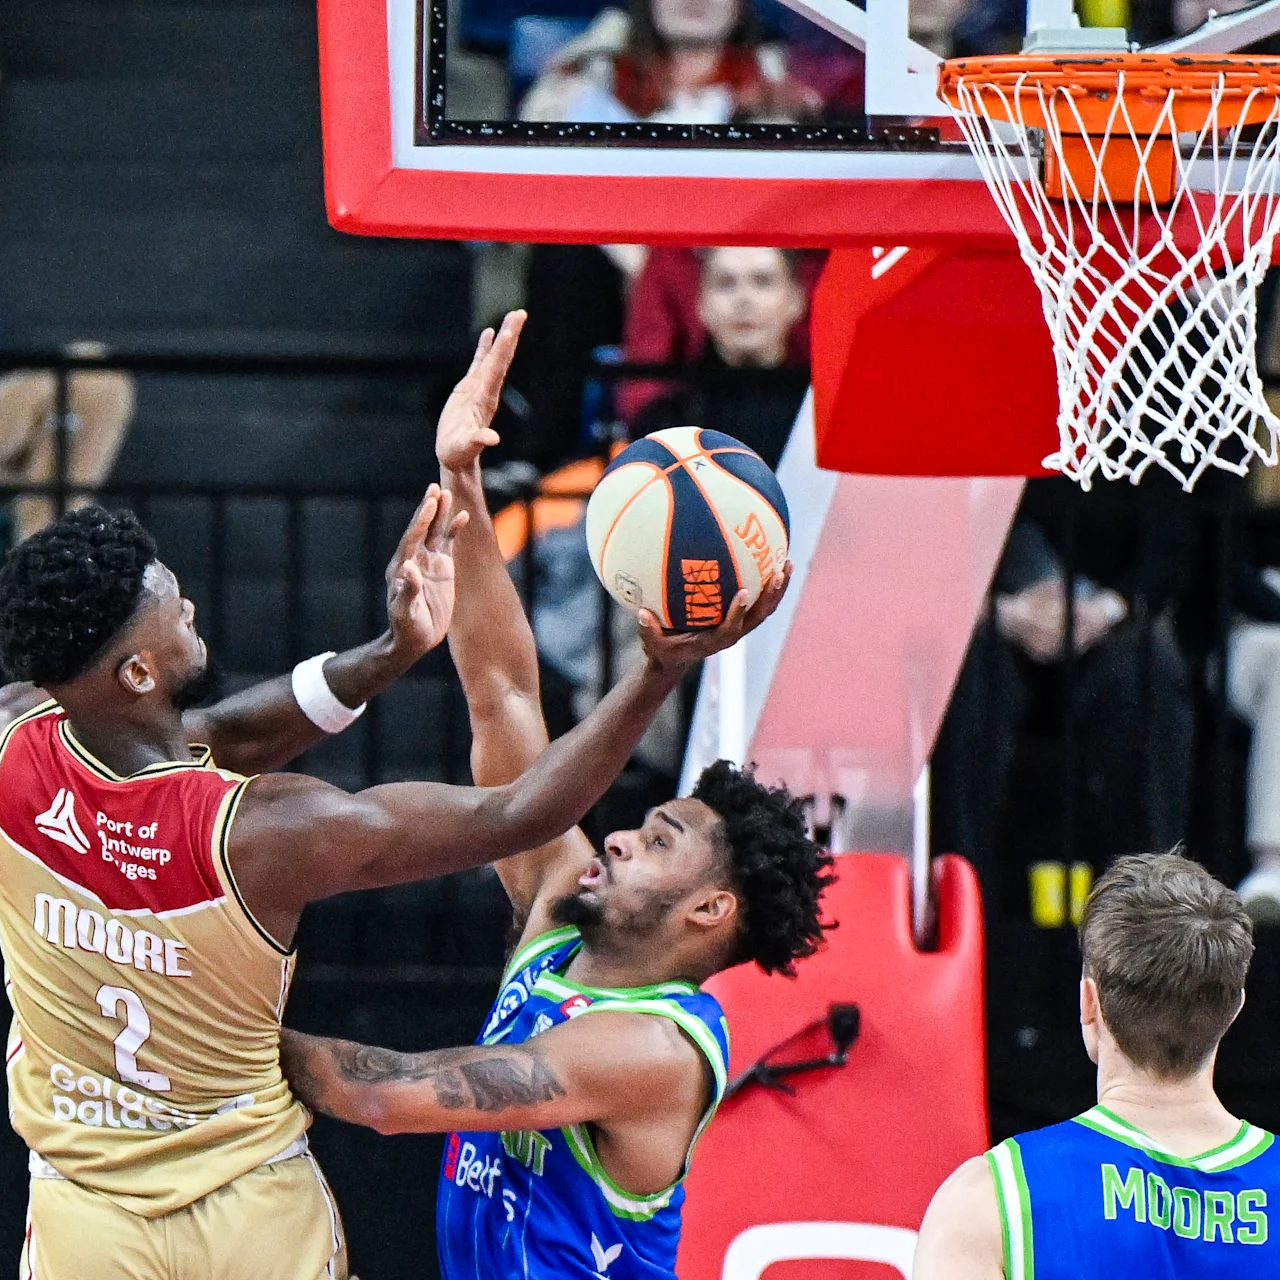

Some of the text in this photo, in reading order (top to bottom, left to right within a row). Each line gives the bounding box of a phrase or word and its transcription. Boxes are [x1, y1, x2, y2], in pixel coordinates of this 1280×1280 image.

[96, 811, 158, 839] Port of
[33, 893, 192, 977] MOORE
[96, 984, 171, 1092] 2
[1102, 1163, 1269, 1246] MOORS
